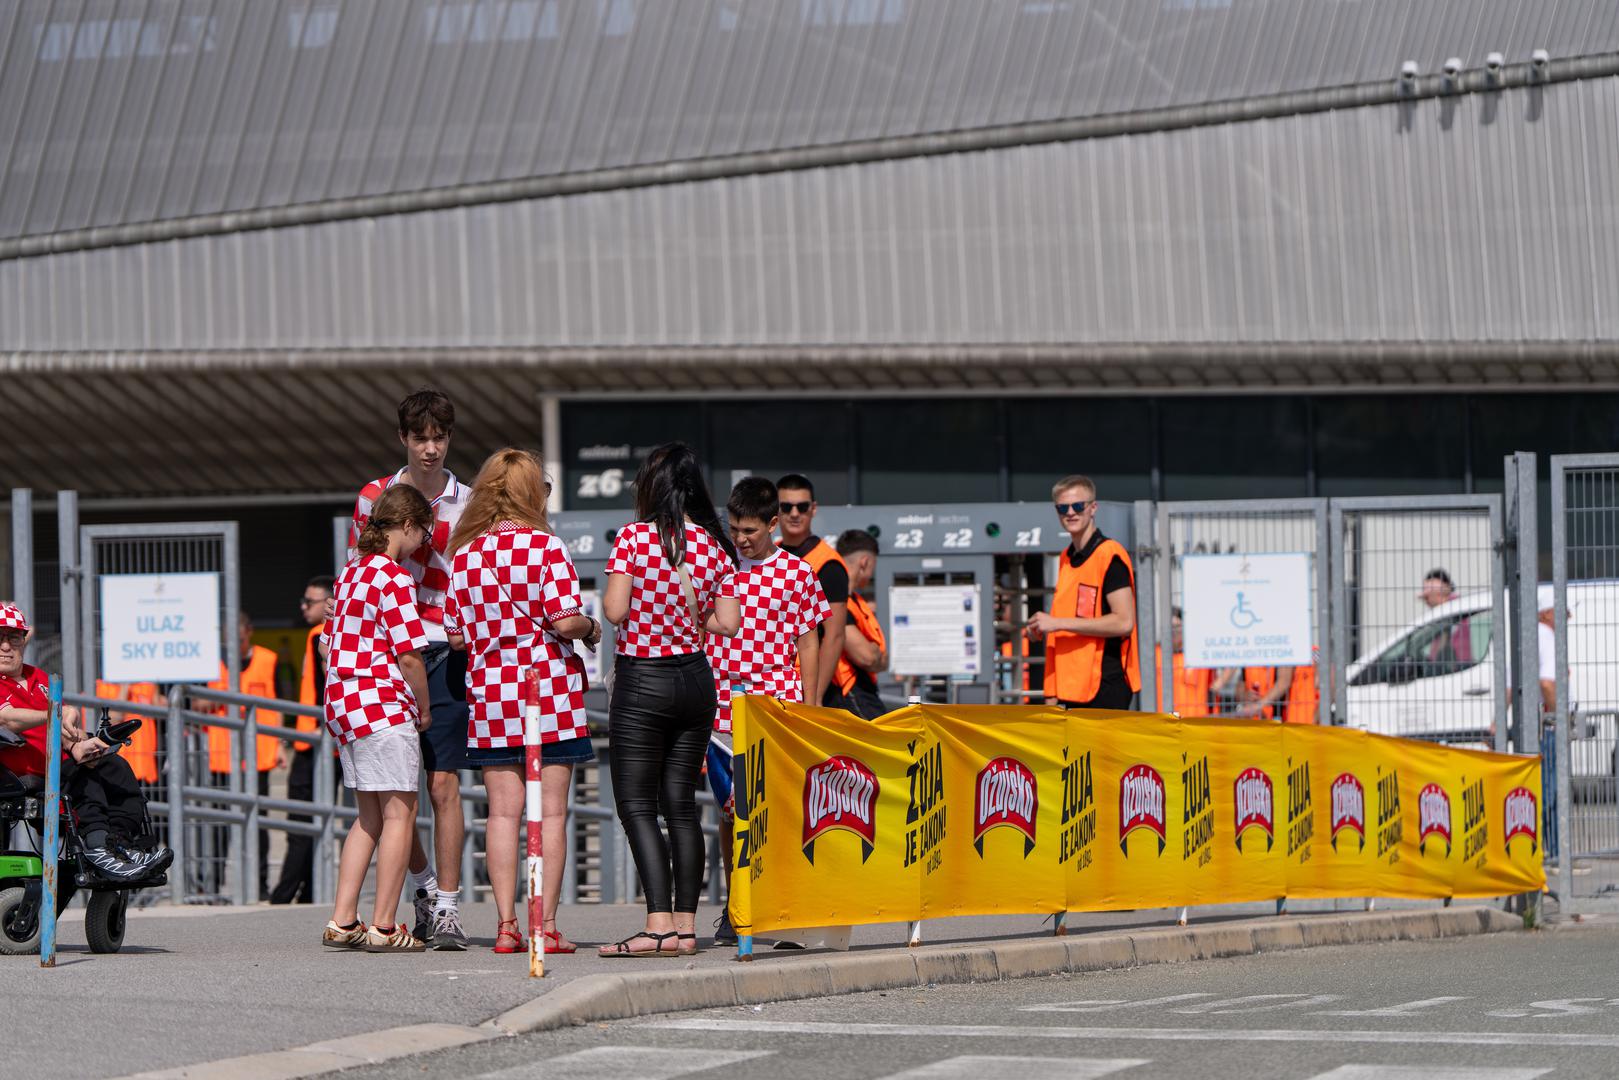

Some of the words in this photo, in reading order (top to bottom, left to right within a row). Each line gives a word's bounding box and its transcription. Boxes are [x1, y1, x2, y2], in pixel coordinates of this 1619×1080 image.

[578, 469, 624, 498] z6
[894, 529, 924, 548] z3
[943, 528, 973, 548] z2
[1016, 528, 1041, 546] z1
[136, 614, 185, 633] ULAZ
[1205, 636, 1232, 647] ULAZ
[1236, 635, 1248, 646] ZA
[1254, 634, 1290, 646] OSOBE
[121, 642, 158, 660] SKY
[163, 640, 200, 659] BOX
[906, 739, 944, 826] ŽUJA
[1061, 746, 1093, 826] ŽUJA
[1182, 751, 1211, 825] ŽUJA
[1287, 755, 1312, 824] ŽUJA
[904, 829, 917, 868] JE
[920, 805, 947, 860] ZAKON!
[1059, 829, 1069, 865] JE
[1070, 808, 1096, 857] ZAKON!
[1191, 809, 1214, 854] ZAKON!
